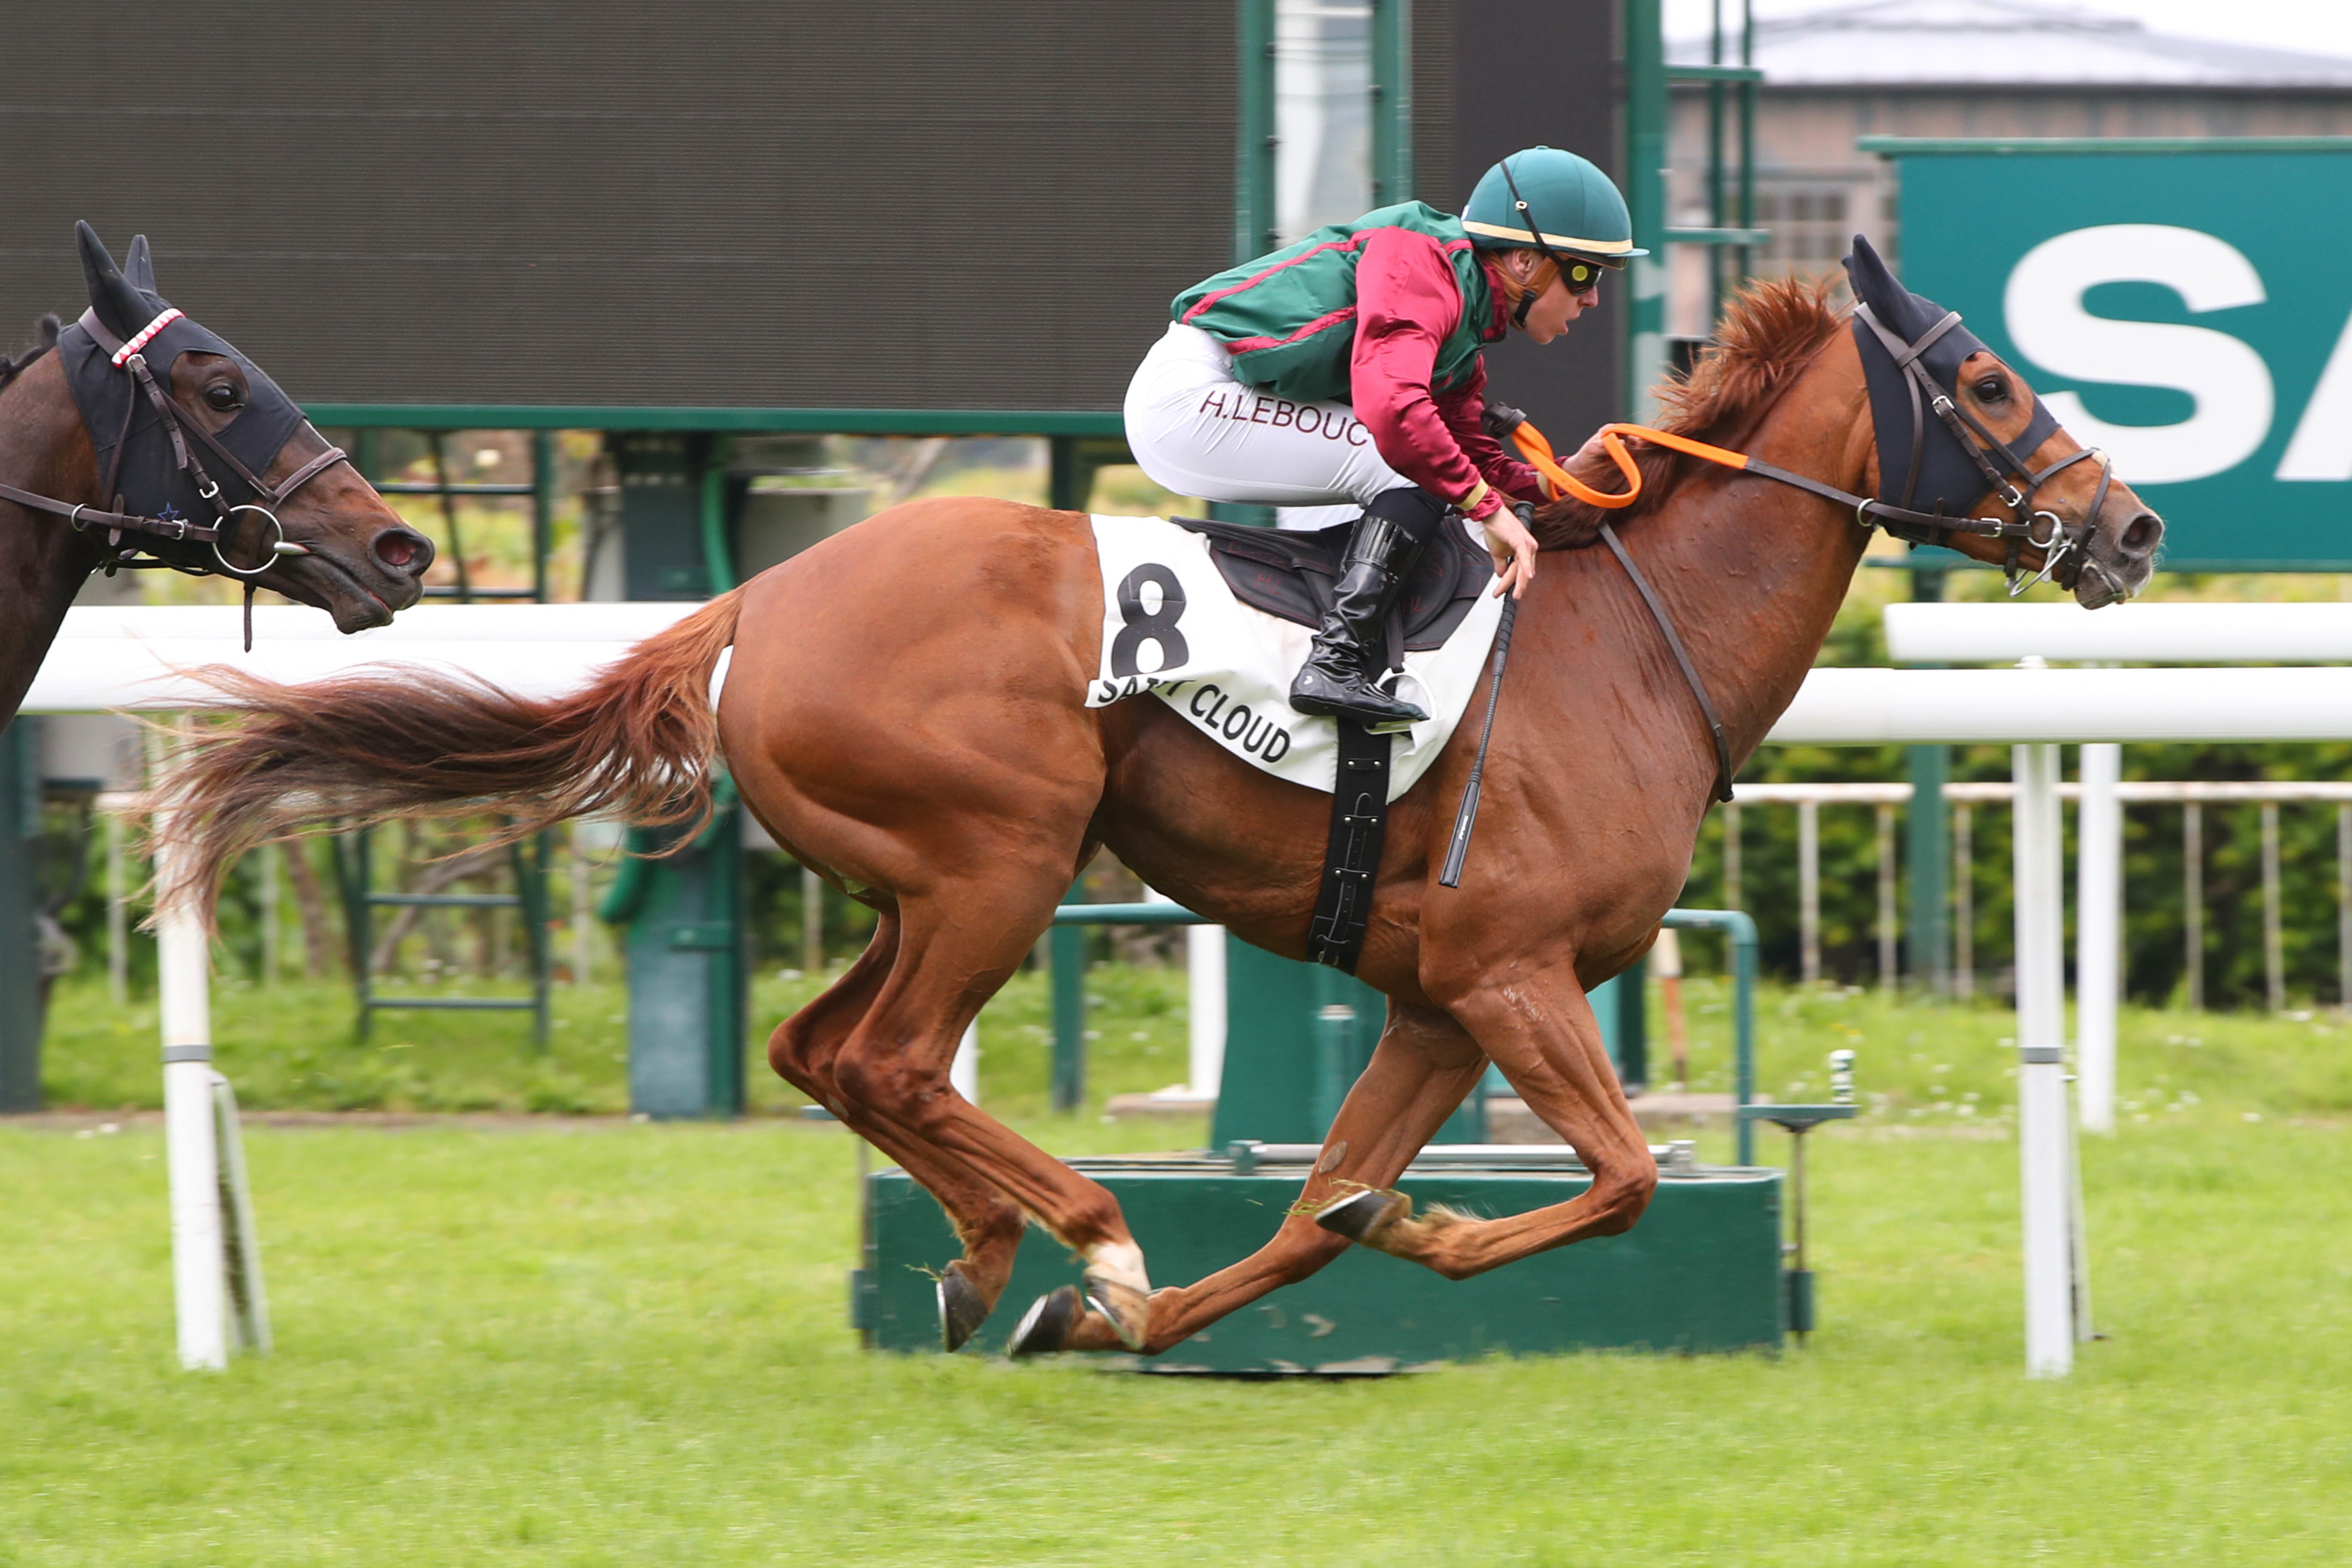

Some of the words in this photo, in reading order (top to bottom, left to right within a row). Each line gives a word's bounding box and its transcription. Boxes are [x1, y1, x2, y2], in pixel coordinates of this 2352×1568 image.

[2004, 223, 2352, 484] S
[1111, 563, 1189, 679] 8
[1190, 684, 1291, 763] CLOUD
